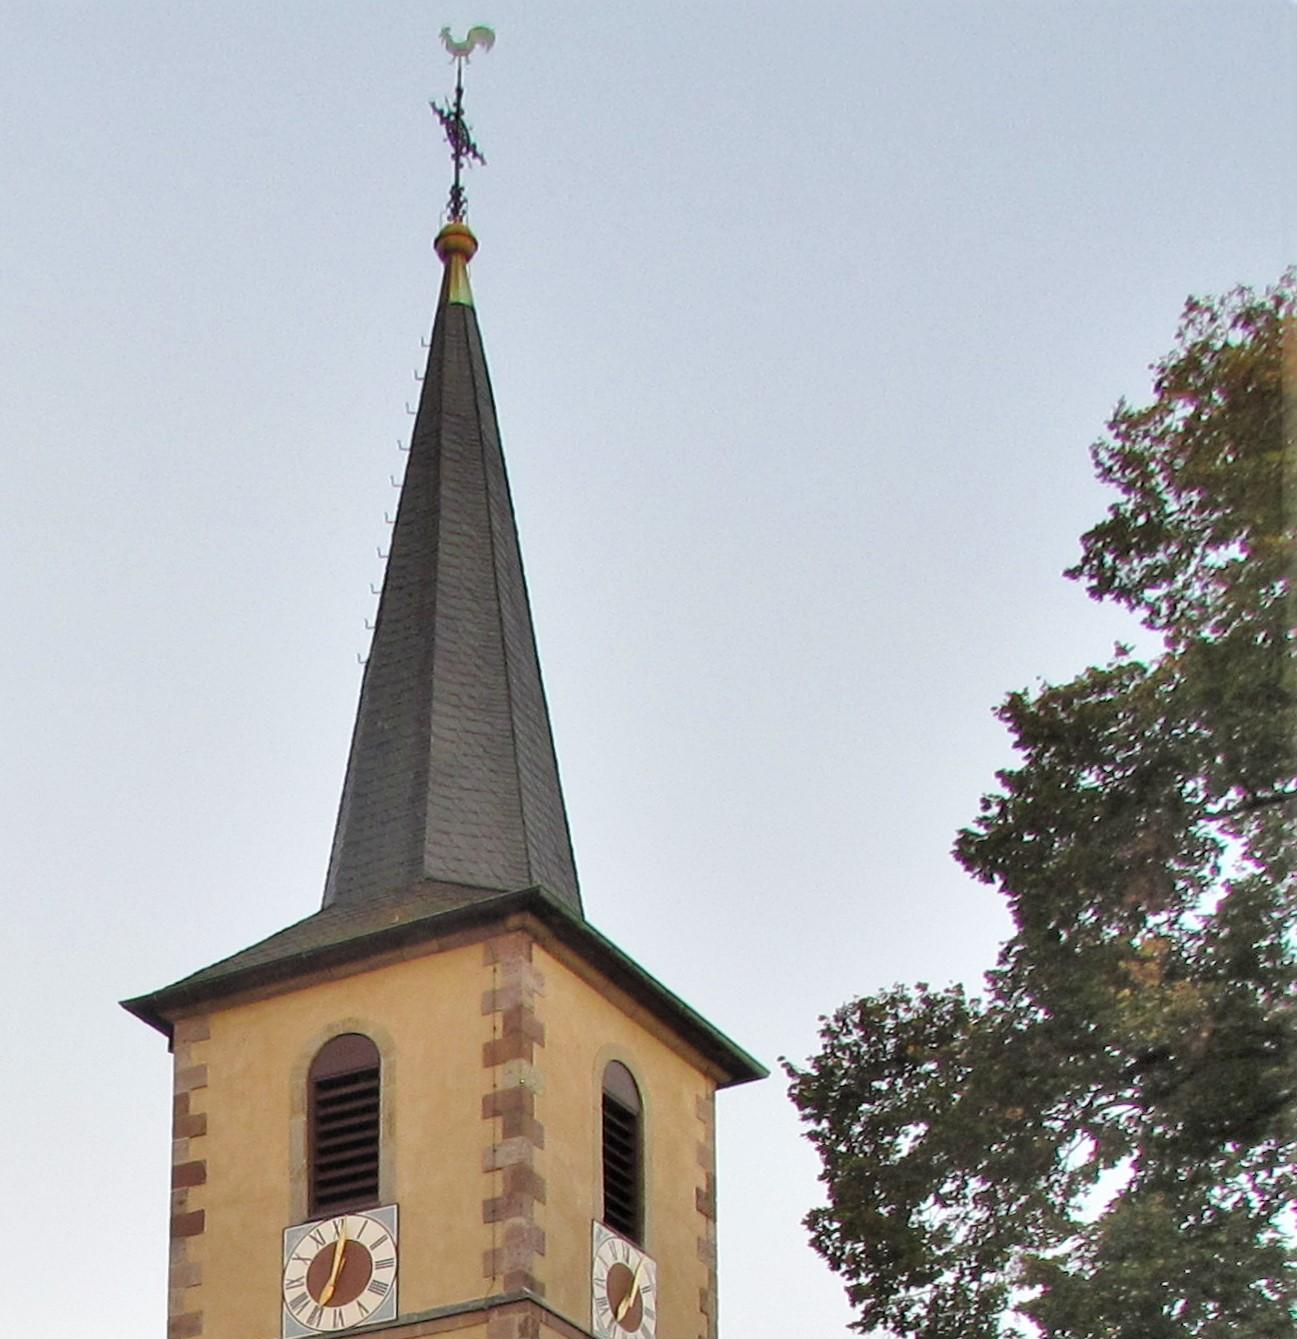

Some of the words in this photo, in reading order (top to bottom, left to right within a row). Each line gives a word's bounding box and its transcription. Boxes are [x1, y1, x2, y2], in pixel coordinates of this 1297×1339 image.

[332, 1218, 345, 1240] XI
[357, 1219, 369, 1239] I
[309, 1229, 326, 1250] XI
[369, 1234, 388, 1251] II
[375, 1257, 394, 1270] III
